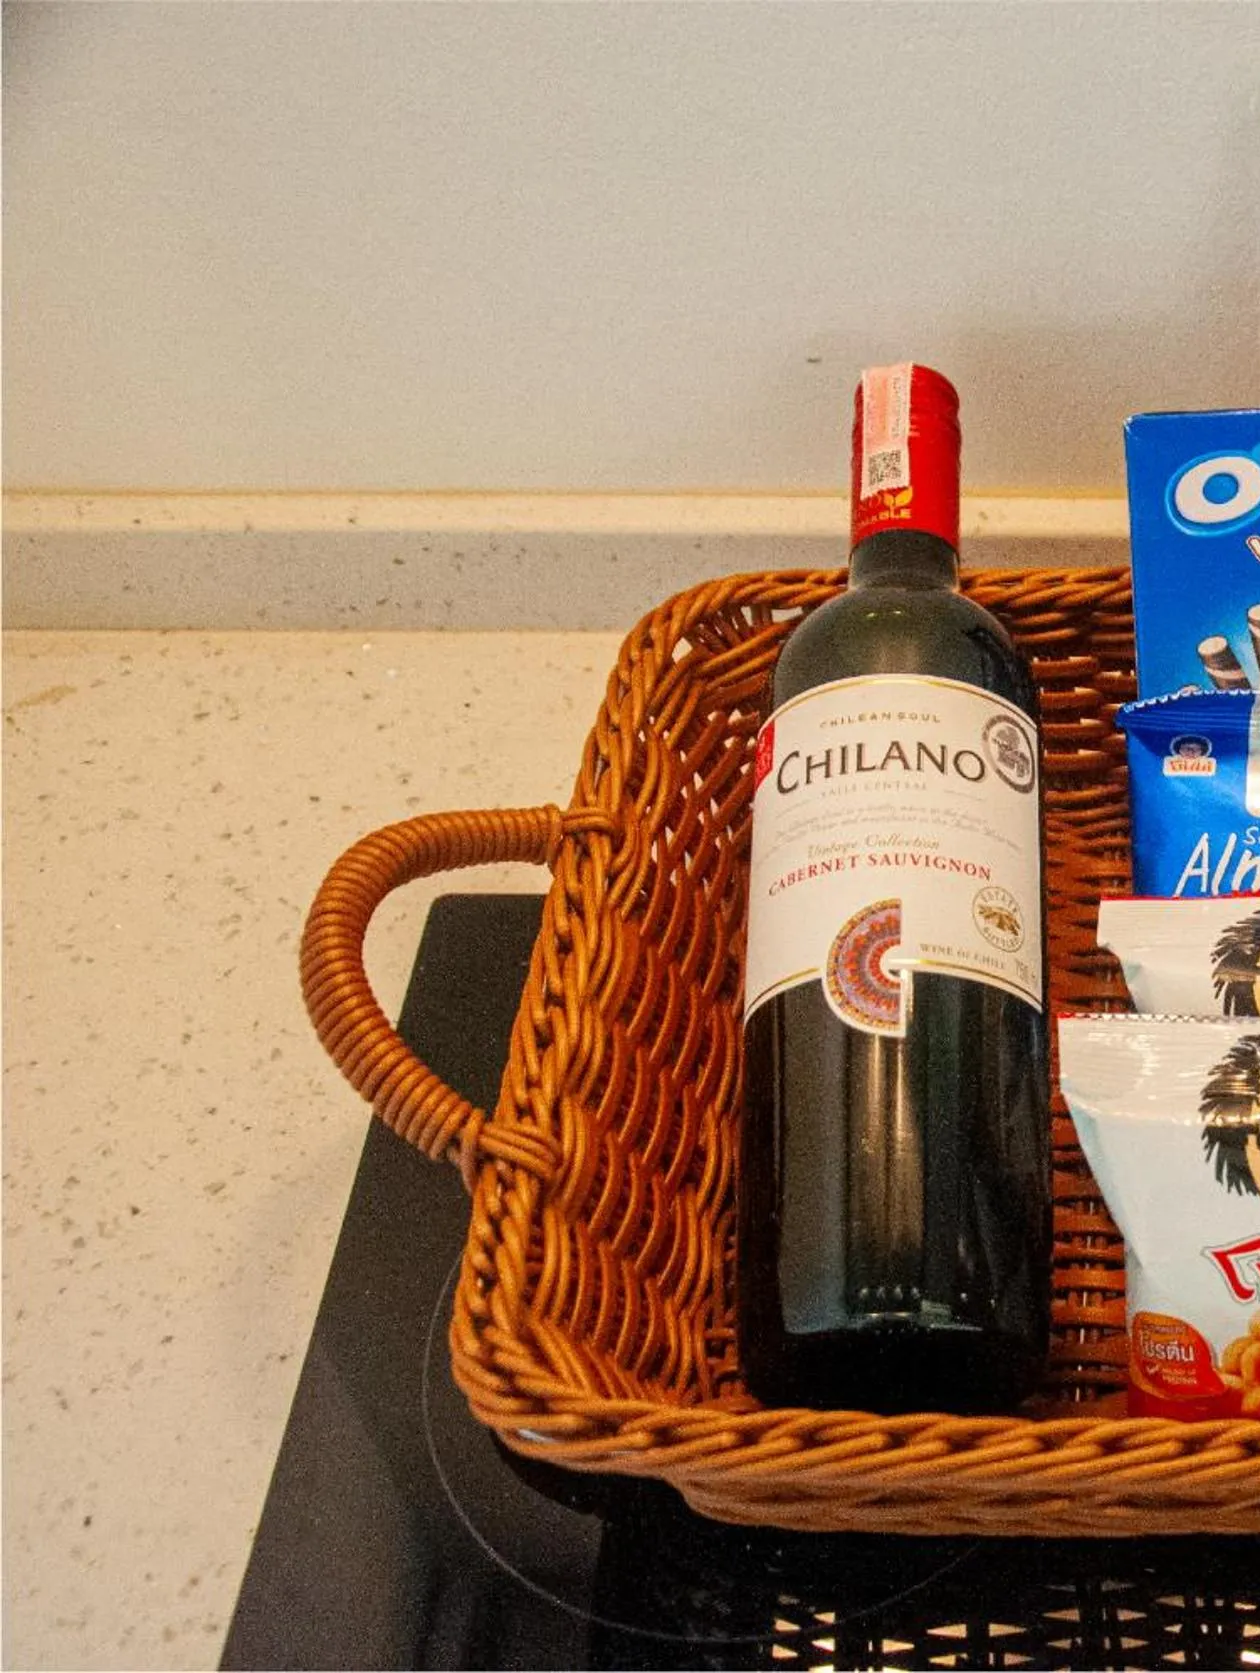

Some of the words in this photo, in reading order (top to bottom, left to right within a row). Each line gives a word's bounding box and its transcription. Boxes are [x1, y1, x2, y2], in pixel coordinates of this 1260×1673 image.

[820, 712, 892, 729] CHILEAN
[897, 711, 941, 723] SOUL
[777, 740, 986, 794] CHILANO
[768, 854, 859, 896] CABERNET
[868, 853, 992, 881] SAUVIGNON
